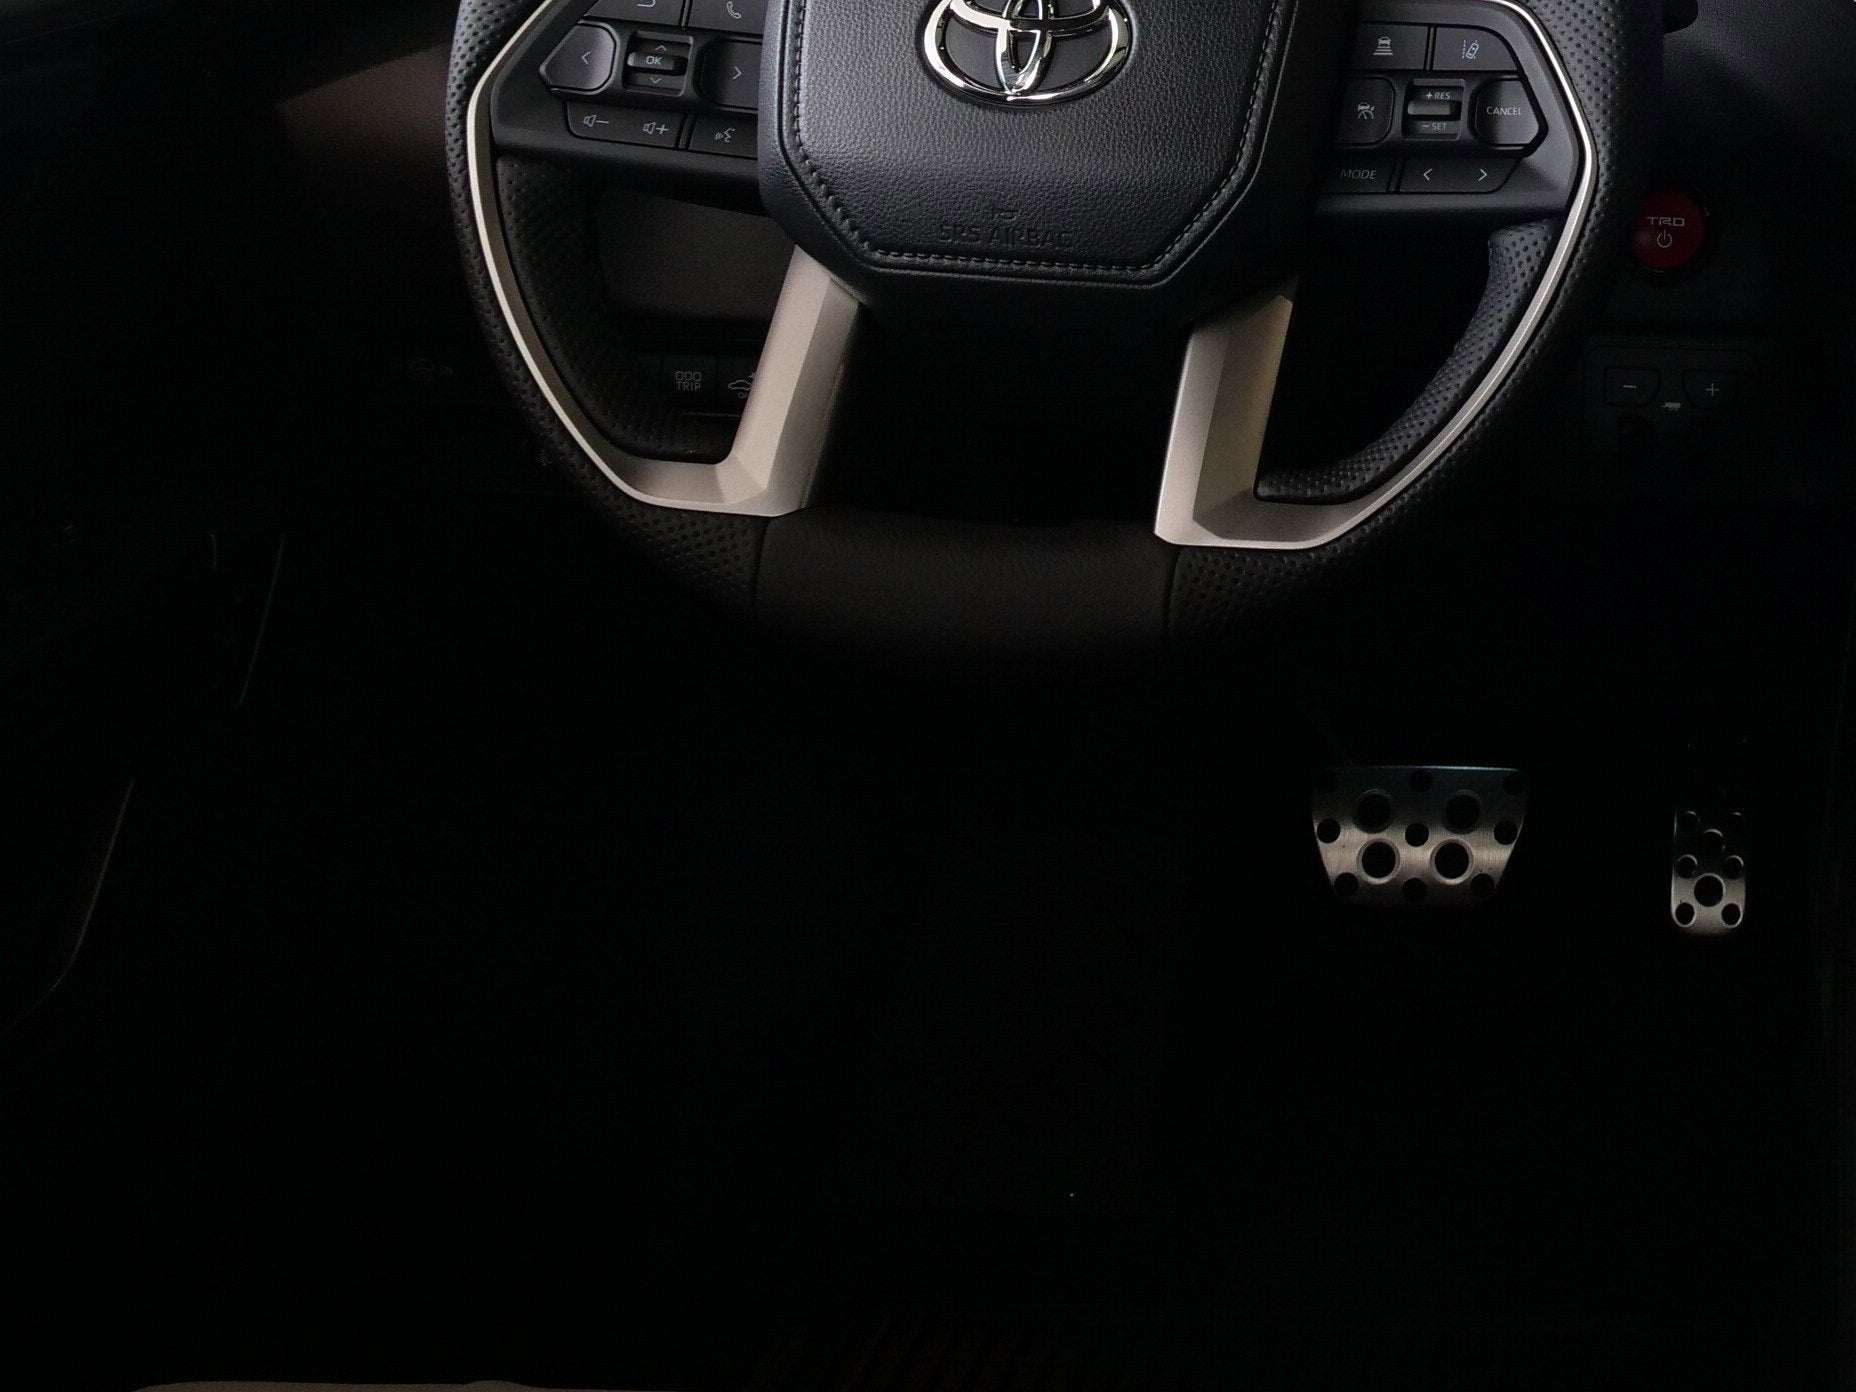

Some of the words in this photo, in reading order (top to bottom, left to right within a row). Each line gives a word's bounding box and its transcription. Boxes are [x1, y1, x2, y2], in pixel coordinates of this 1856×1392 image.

[645, 55, 662, 66] OK
[1486, 106, 1522, 116] CANCEL
[1340, 168, 1377, 180] MODE
[1646, 216, 1686, 227] TRD
[676, 381, 701, 391] TRIP
